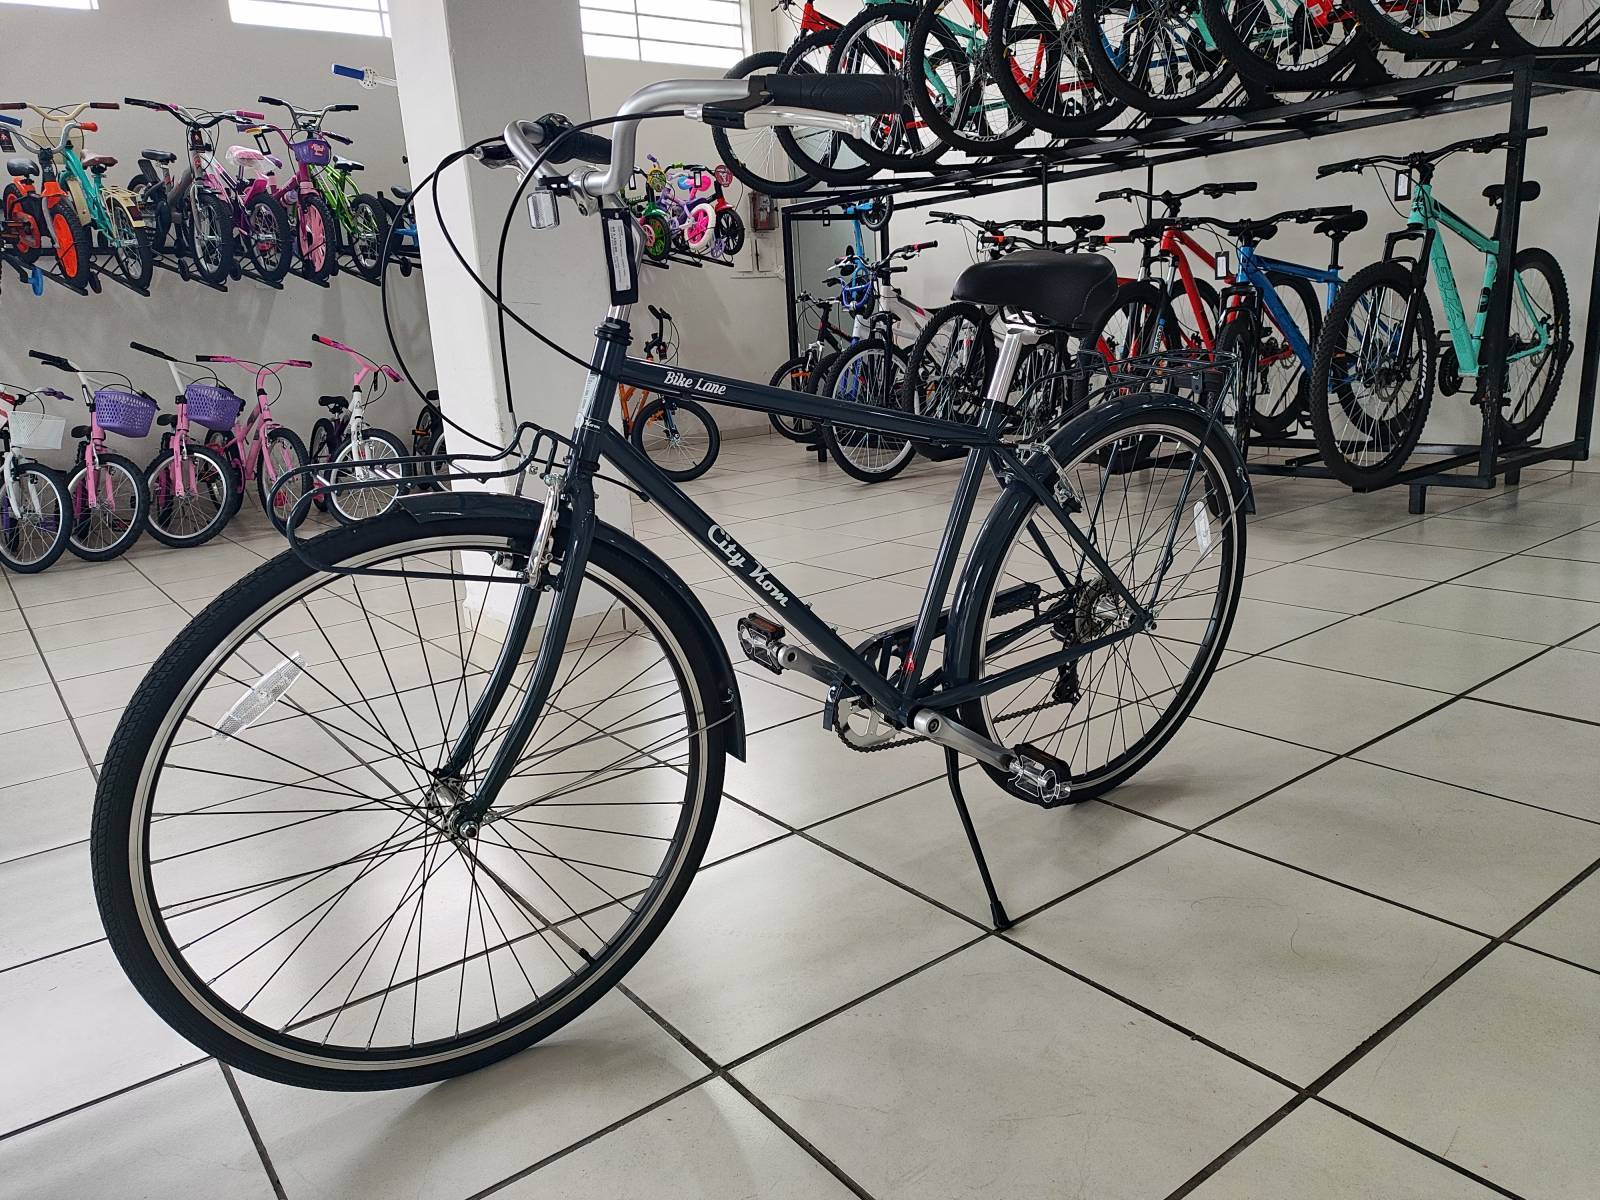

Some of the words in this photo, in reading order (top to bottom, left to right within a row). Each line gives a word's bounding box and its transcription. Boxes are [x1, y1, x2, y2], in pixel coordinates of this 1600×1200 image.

[664, 371, 693, 388] Bike
[694, 378, 727, 395] Lane
[708, 525, 747, 568] City
[749, 560, 789, 607] Kom
